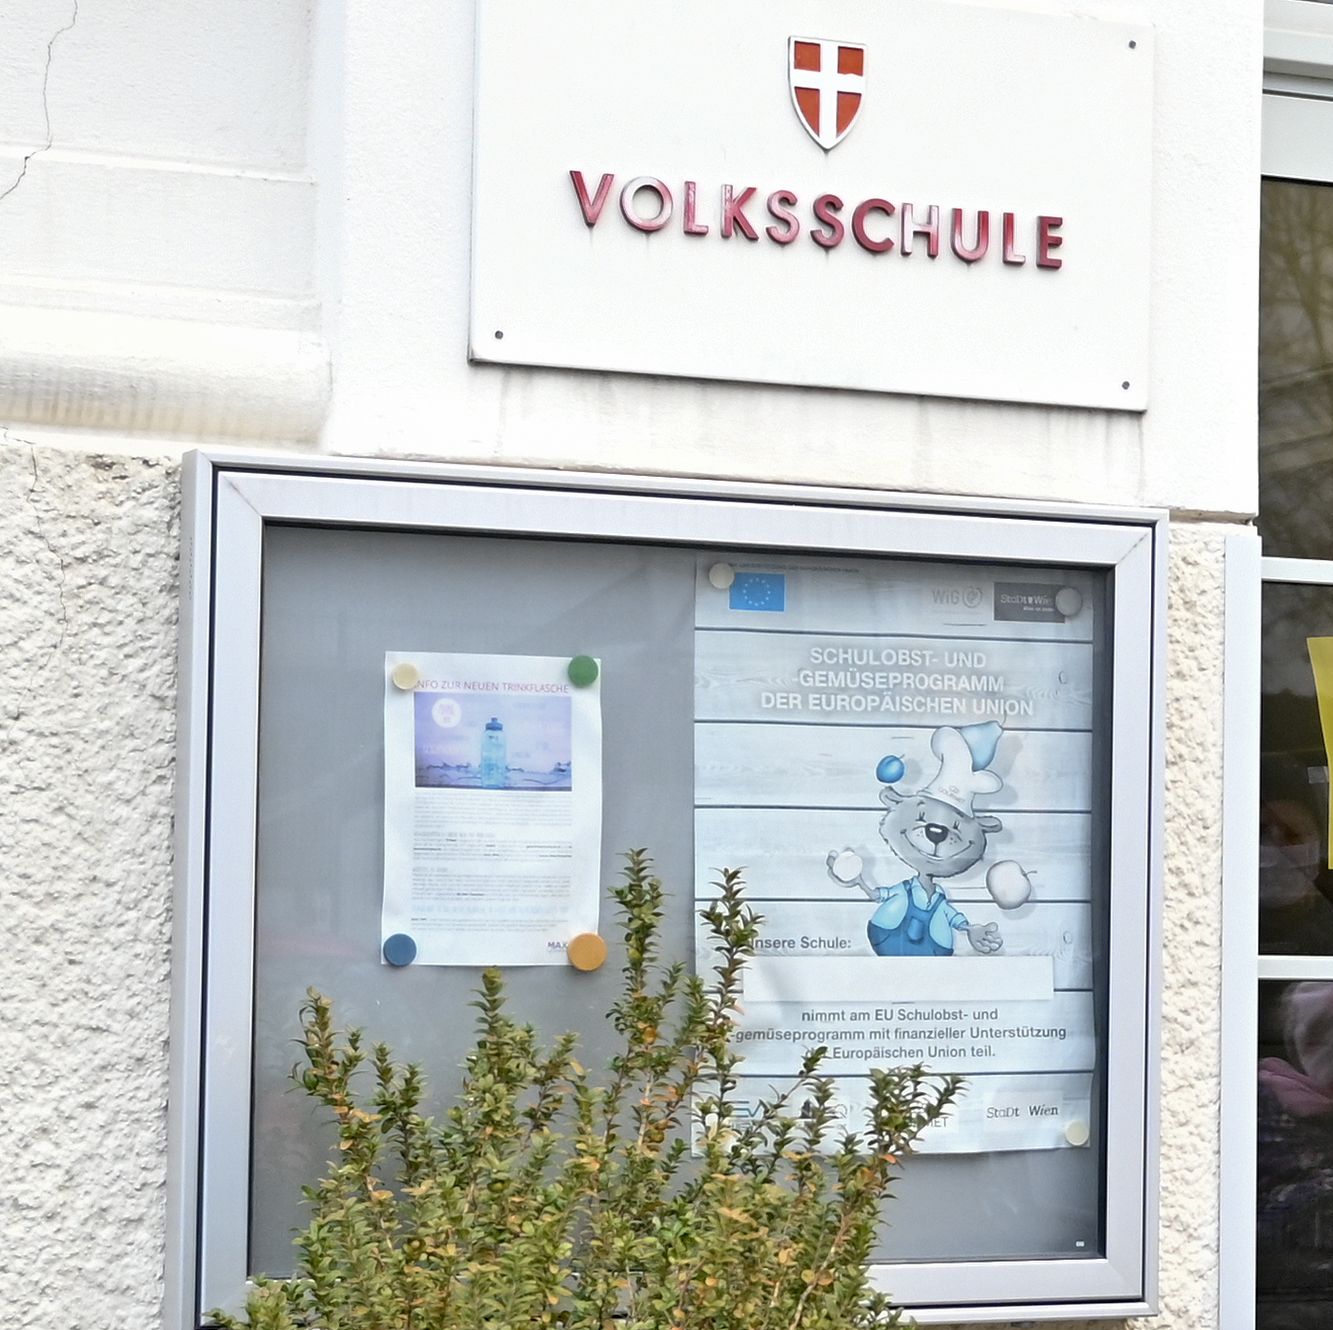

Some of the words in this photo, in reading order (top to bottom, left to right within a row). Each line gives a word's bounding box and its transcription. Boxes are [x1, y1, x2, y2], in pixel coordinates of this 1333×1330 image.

[569, 168, 1064, 270] VOLKSSCHULE
[810, 647, 940, 668] SCHULOBST-
[943, 651, 987, 669] UND
[441, 680, 462, 691] ZUR
[463, 681, 499, 692] NEUEN
[502, 683, 569, 694] TRINKFLASCHE
[791, 667, 1005, 693] -GEMÜSEPROGRAMM
[760, 690, 802, 710] DER
[807, 690, 967, 715] EUROPÄISCHEN
[972, 697, 1034, 717] UNION
[800, 934, 853, 951] Schule:
[801, 1009, 846, 1022] nimmt
[849, 1012, 871, 1022] am
[874, 1009, 894, 1022] EU
[897, 1008, 969, 1023] Schulobst-
[972, 1008, 999, 1020] und
[729, 1028, 866, 1046] -gemüseprogramm
[868, 1029, 891, 1041] mit
[894, 1027, 967, 1040] finanzieller
[969, 1026, 1067, 1043] Unterstützung
[832, 1046, 924, 1062] Europäischen
[928, 1045, 967, 1058] Union
[970, 1045, 996, 1058] teil.
[986, 1106, 1020, 1119] StaDt
[1028, 1104, 1060, 1117] Wien
